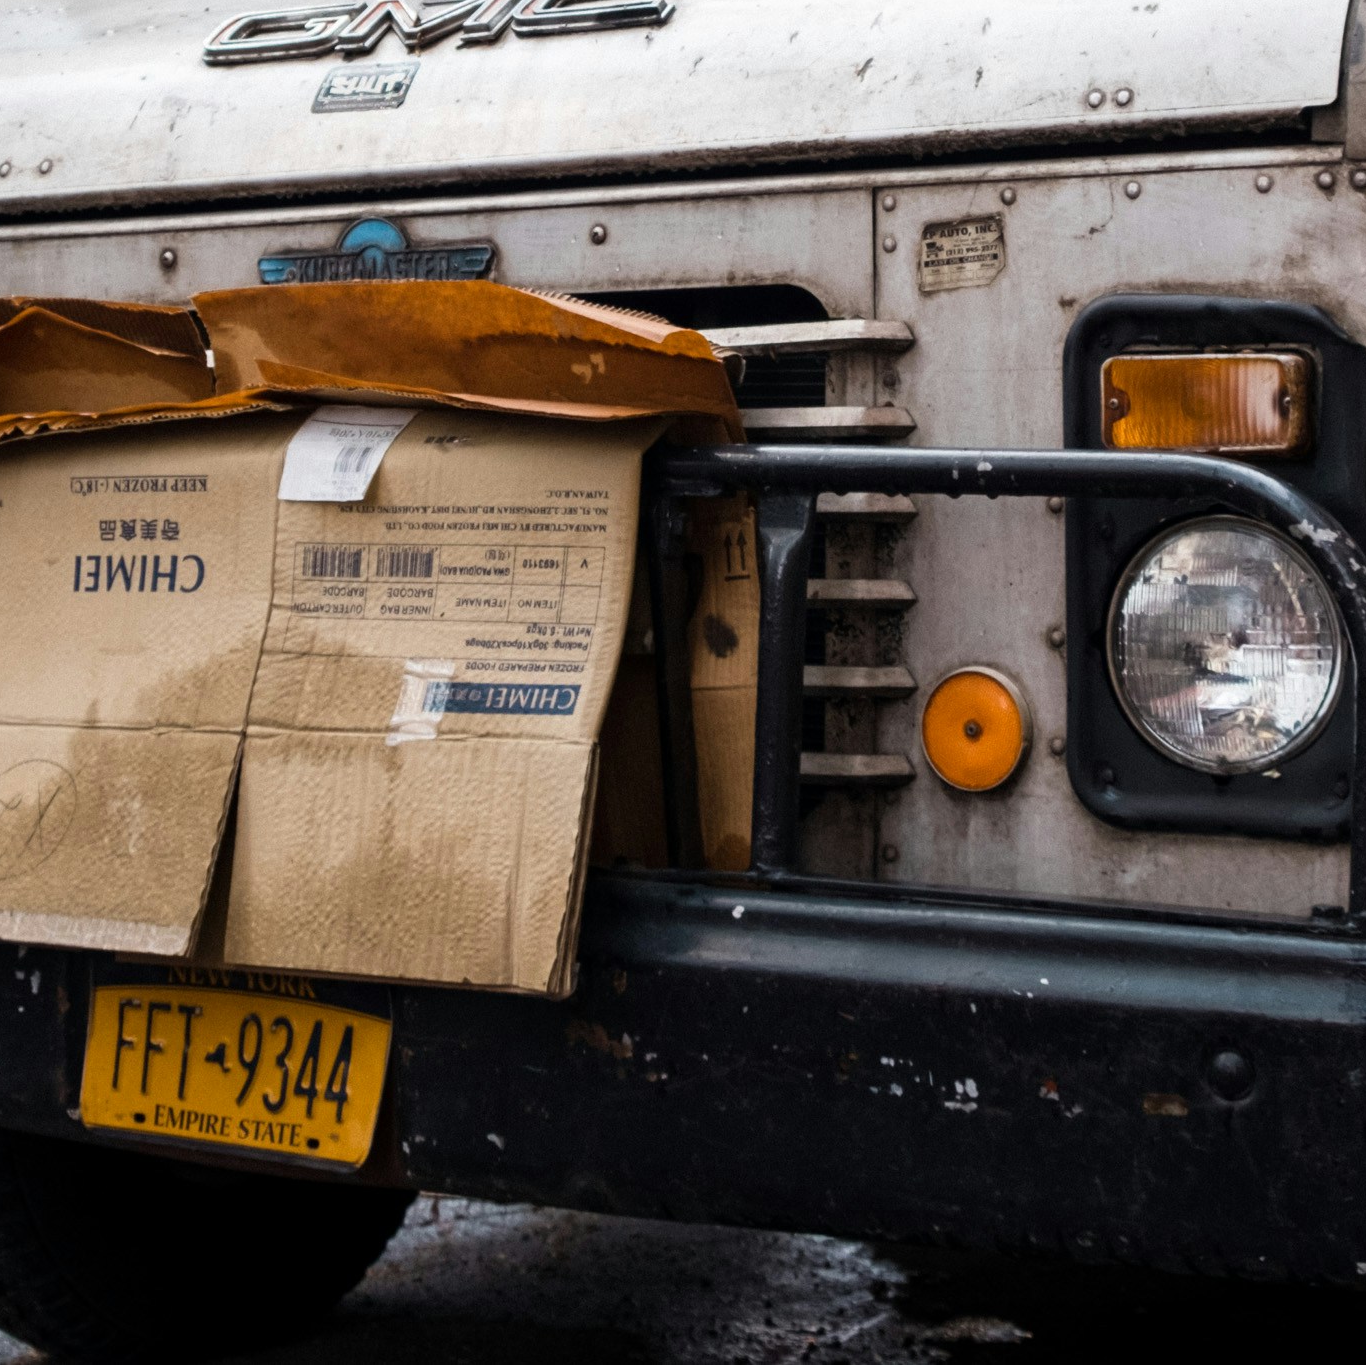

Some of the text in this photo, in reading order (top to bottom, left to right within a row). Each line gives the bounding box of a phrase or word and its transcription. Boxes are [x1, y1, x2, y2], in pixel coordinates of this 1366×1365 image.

[940, 227, 972, 237] AUTO,
[975, 223, 997, 233] INC.
[114, 478, 168, 492] FROZEN
[170, 478, 208, 492] KEEP
[99, 519, 180, 541] 奇美食品
[421, 522, 445, 530] FOOD
[446, 522, 480, 531] FROZEN
[519, 523, 530, 532] BY
[530, 523, 607, 532] MANUFACTURED
[72, 555, 205, 594] CHIMEI
[322, 586, 365, 597] BARCODE
[387, 587, 434, 598] BARCODE
[293, 602, 363, 614] OUTER CARTON
[455, 598, 507, 608] ITEM NAME
[517, 599, 558, 609] ITEM NO
[380, 604, 432, 615] INNER BAG
[552, 640, 588, 652] Packing:
[464, 661, 585, 673] FROZEN PREPARED FOODS
[485, 687, 576, 711] CHIMEI
[168, 965, 317, 999] NEW YORK
[153, 1104, 303, 1149] EMPIRE STATE
